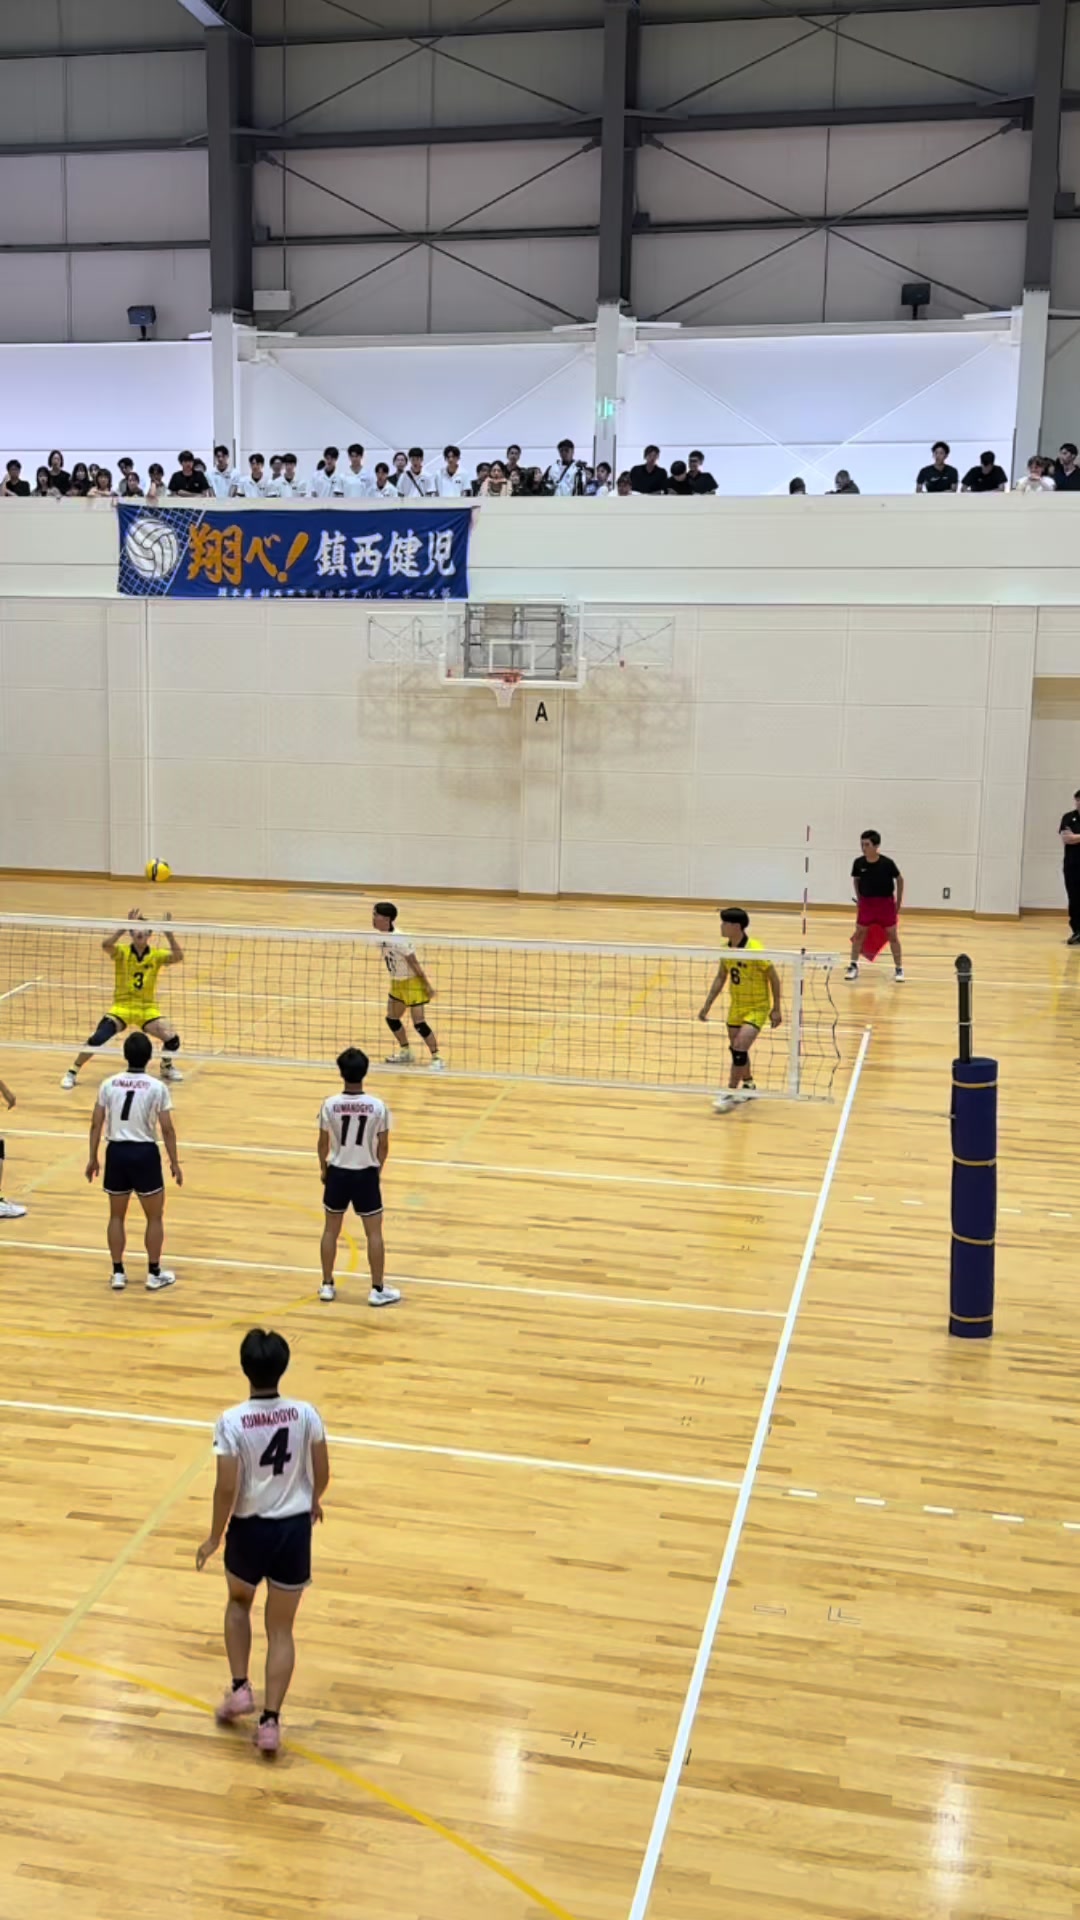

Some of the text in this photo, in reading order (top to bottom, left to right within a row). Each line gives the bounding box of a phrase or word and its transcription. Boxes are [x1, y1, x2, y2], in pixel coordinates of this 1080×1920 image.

[314, 529, 457, 578] 鎮西健児
[535, 702, 548, 722] A
[133, 972, 144, 990] 3
[120, 1090, 135, 1121] 1
[341, 1115, 368, 1146] 11
[259, 1427, 292, 1476] 4
